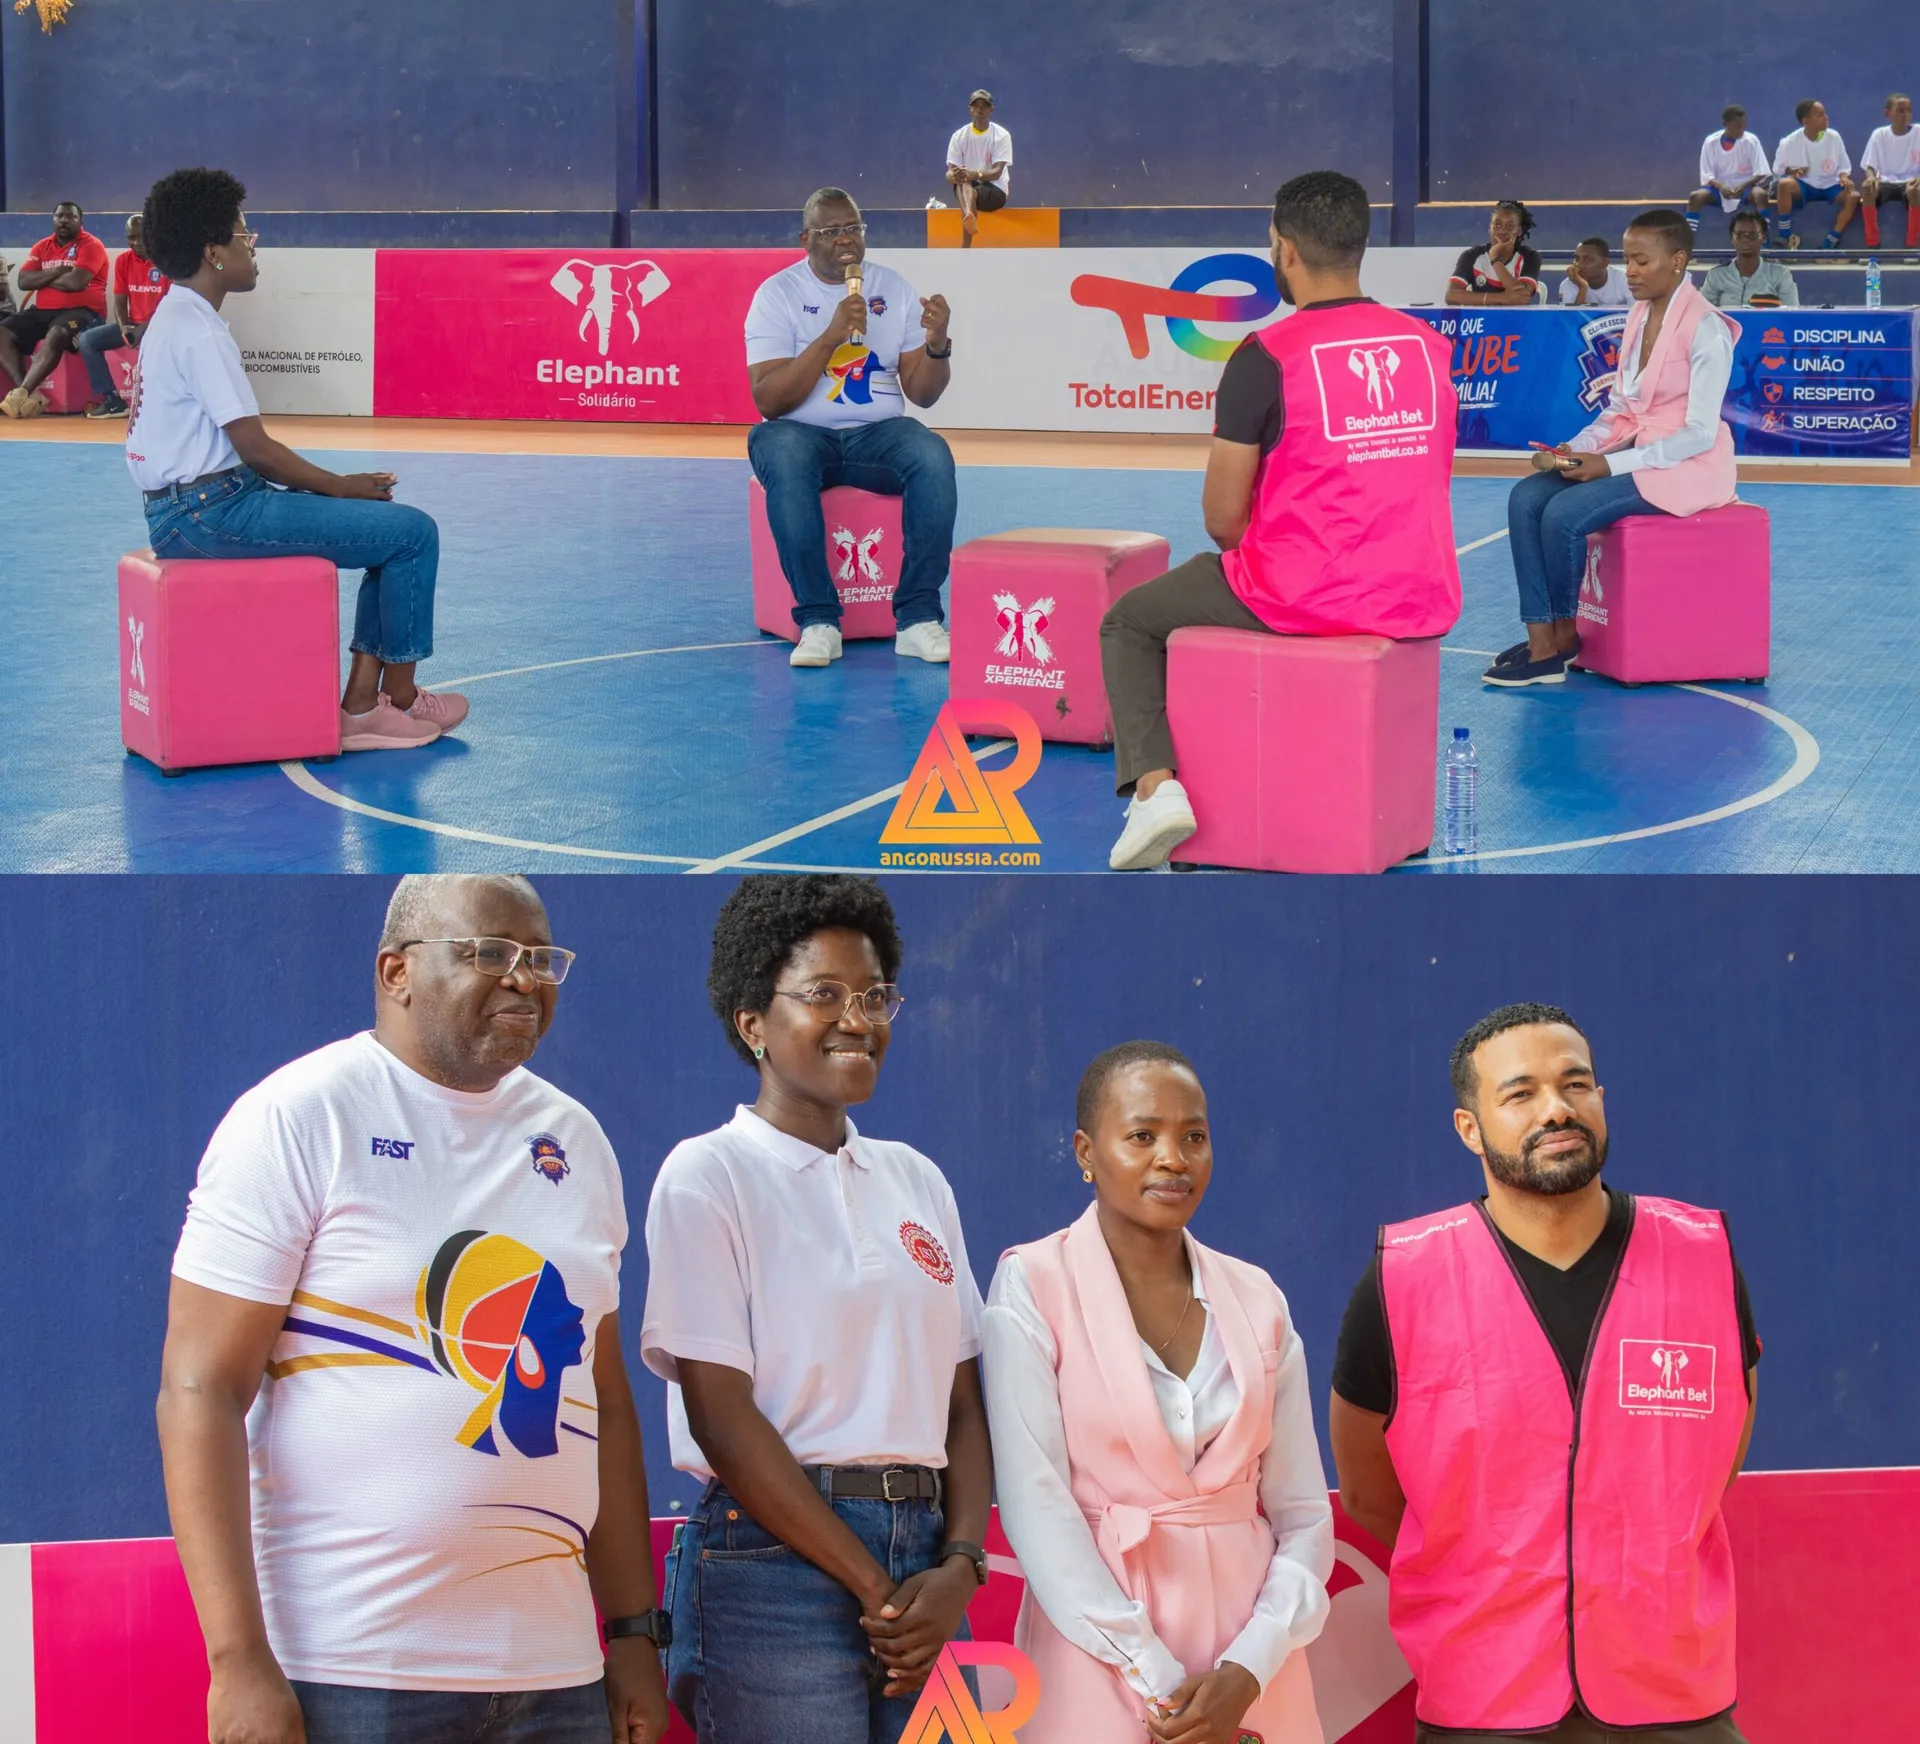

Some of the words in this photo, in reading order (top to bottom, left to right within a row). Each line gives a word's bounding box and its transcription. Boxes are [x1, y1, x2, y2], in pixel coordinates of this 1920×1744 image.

[1440, 319, 1457, 335] DO
[1460, 317, 1485, 336] QUE
[1793, 329, 1886, 344] DISCIPLINA
[240, 351, 257, 360] CIA
[258, 351, 302, 360] NACIONAL
[304, 352, 316, 361] DE
[317, 350, 363, 362] PETRÓLEO,
[1793, 355, 1845, 372] UNIÃO
[245, 363, 321, 373] BIOCOMBUSTÍVEIS
[536, 359, 680, 389] Elephant
[577, 392, 637, 408] Solidário
[1793, 387, 1875, 402] RESPEITO
[1345, 411, 1400, 432] Elephant
[1401, 408, 1424, 424] Bet
[1793, 413, 1897, 434] SUPERAÇÃO
[1347, 445, 1428, 463] elephantbet.co.ao
[985, 664, 1065, 680] ELEPHANT
[984, 674, 1065, 690] XPERIENCE
[371, 1136, 415, 1160] FAST
[1628, 1384, 1685, 1401] Elephant
[1688, 1387, 1708, 1402] Bet
